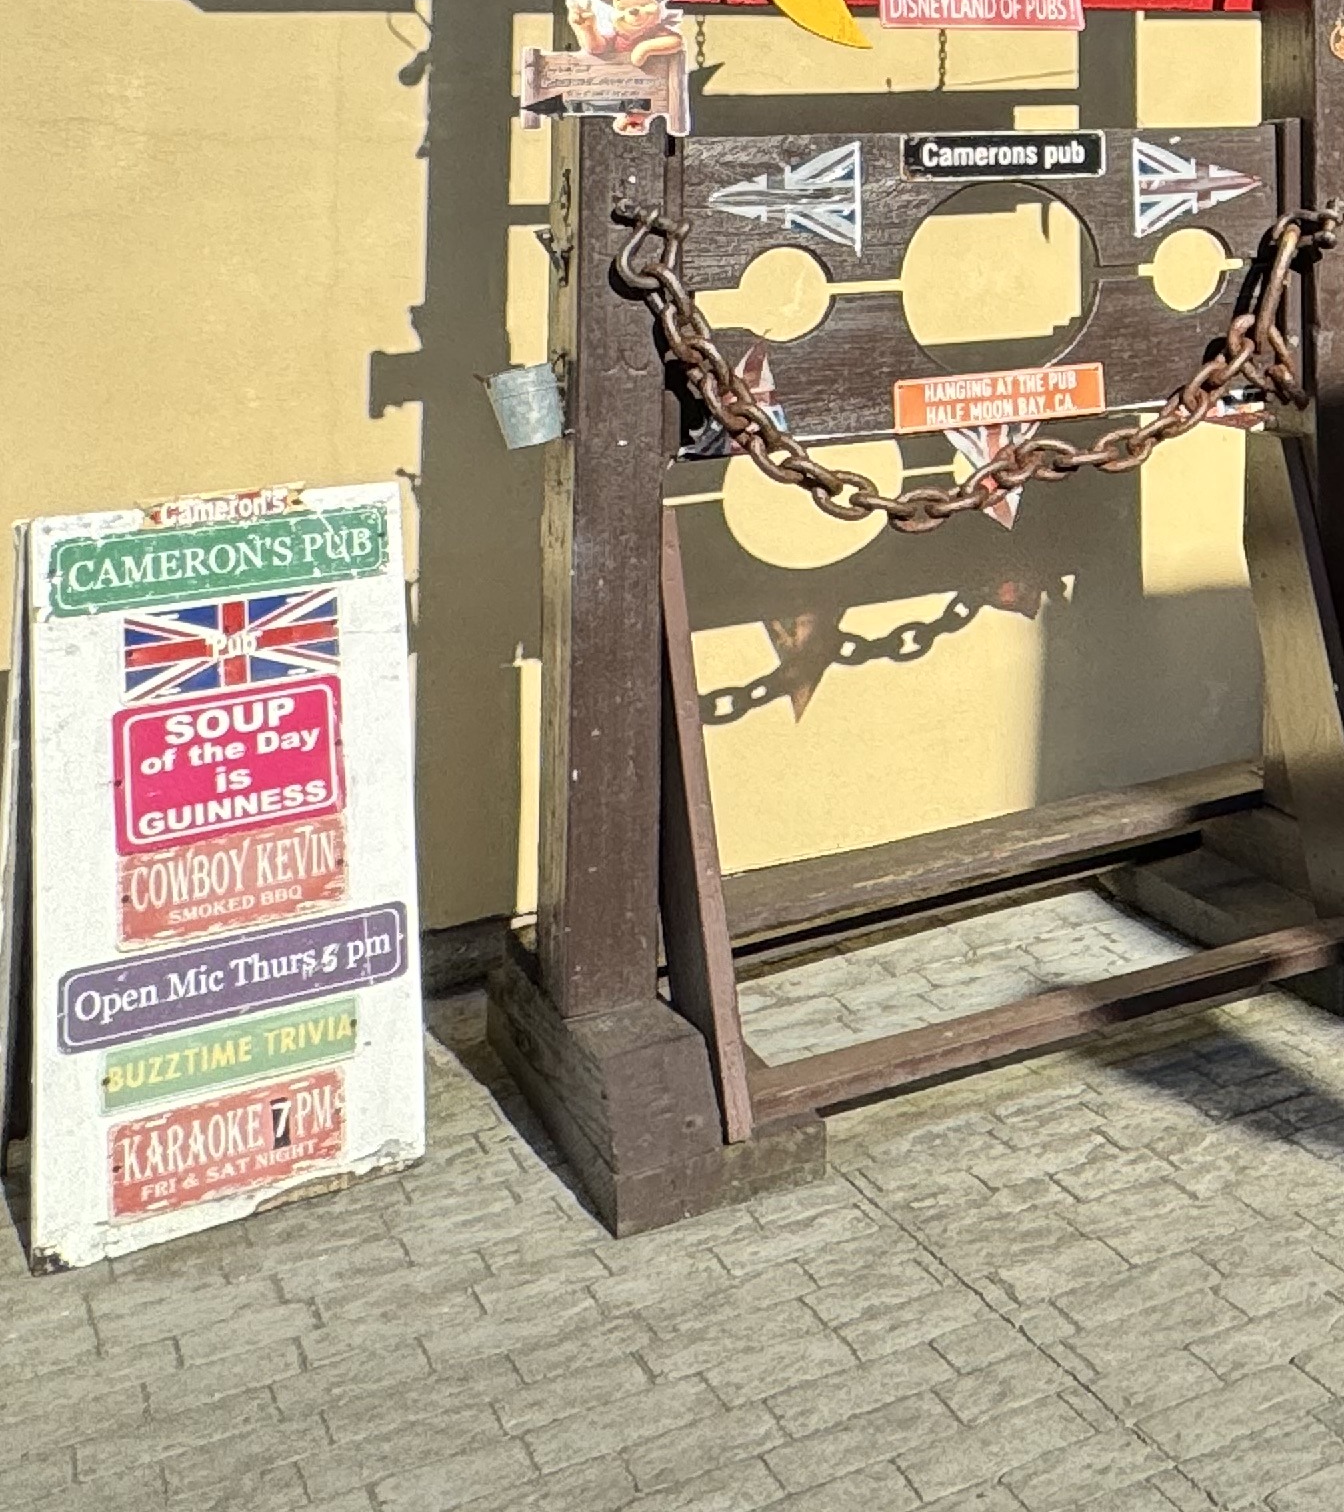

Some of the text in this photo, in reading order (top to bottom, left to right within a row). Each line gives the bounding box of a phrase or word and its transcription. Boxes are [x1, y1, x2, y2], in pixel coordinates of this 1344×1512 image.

[922, 141, 1086, 170] Camerons pub
[924, 370, 1077, 402] HANGING AT THE PUB
[925, 403, 967, 426] HALF
[970, 398, 1014, 421] MOON
[158, 488, 289, 528] Cameron's
[67, 526, 372, 593] CAMERON'S PUB
[209, 631, 260, 662] Pub
[164, 695, 295, 746] SOUP
[140, 725, 321, 775] of the Day
[215, 766, 253, 794] is
[138, 779, 328, 836] GUINNESS
[129, 827, 337, 913] COWBOY KEVIN
[168, 884, 303, 925] SMOKED BBQ
[74, 983, 160, 1024] Open
[166, 964, 224, 1003] Mic
[230, 949, 316, 981] Thurs
[345, 932, 392, 970] pm
[105, 1014, 354, 1093] BUZZTIME TRIVIA
[120, 1085, 334, 1183] KARAOKE 7 PM
[140, 1140, 317, 1203] FRI & SAT NIGHT
